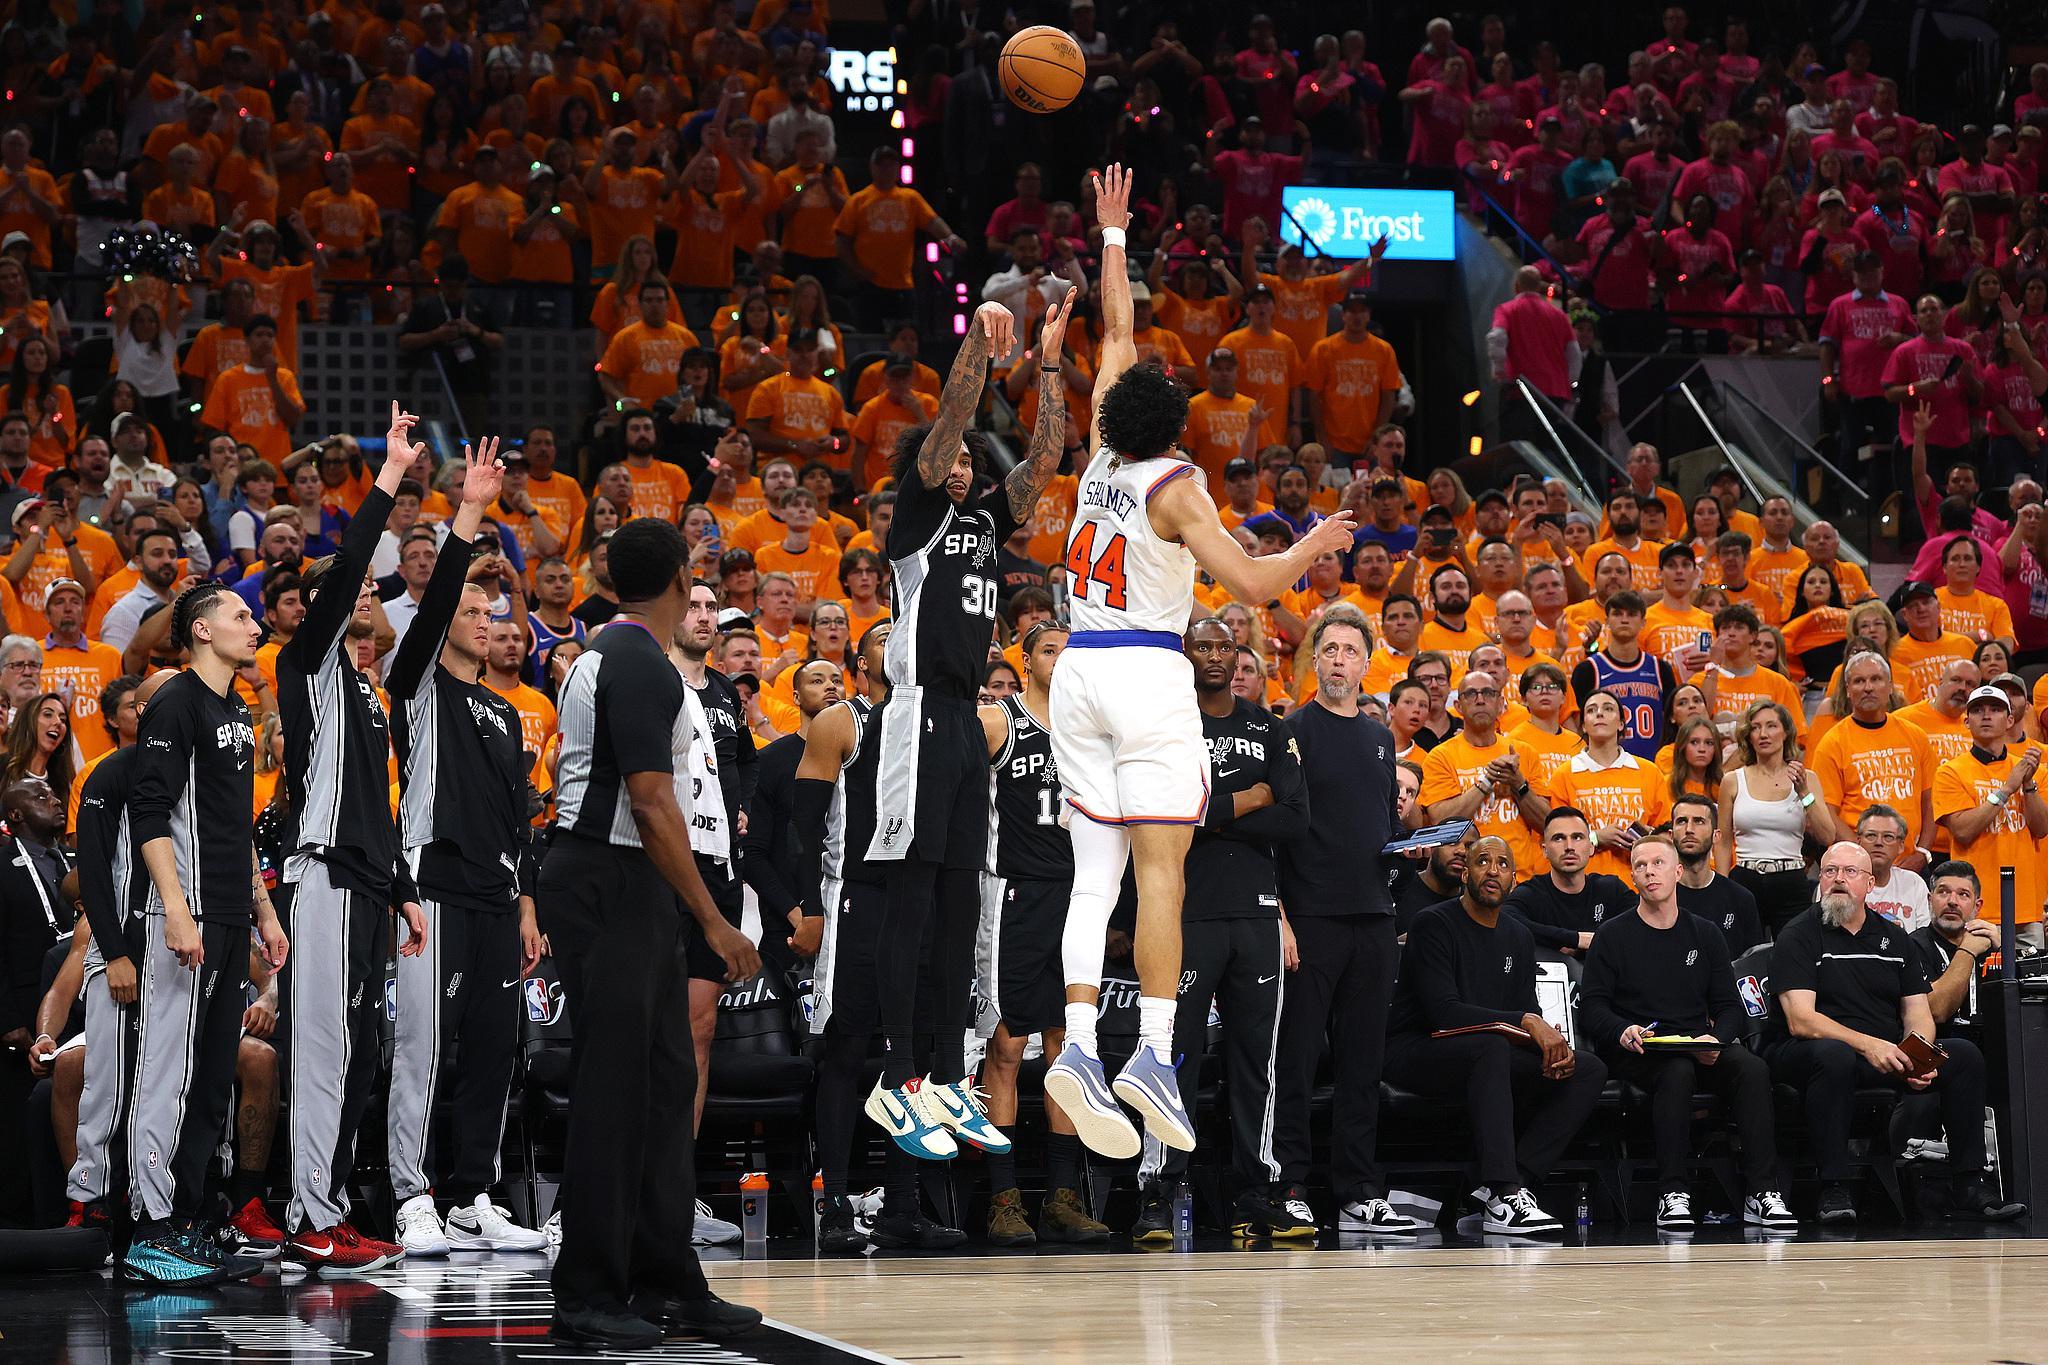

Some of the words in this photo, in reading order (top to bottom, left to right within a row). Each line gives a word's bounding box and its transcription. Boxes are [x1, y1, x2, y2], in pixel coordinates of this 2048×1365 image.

[826, 47, 894, 93] RS
[1341, 206, 1425, 242] Frost
[1083, 481, 1138, 522] SHAMET
[1067, 520, 1127, 612] 44
[962, 573, 998, 620] 30
[75, 695, 99, 718] GO
[1203, 736, 1265, 766] PURS
[1852, 754, 1916, 786] FINALS
[1498, 798, 1520, 824] GO
[1575, 794, 1645, 820] FINALS
